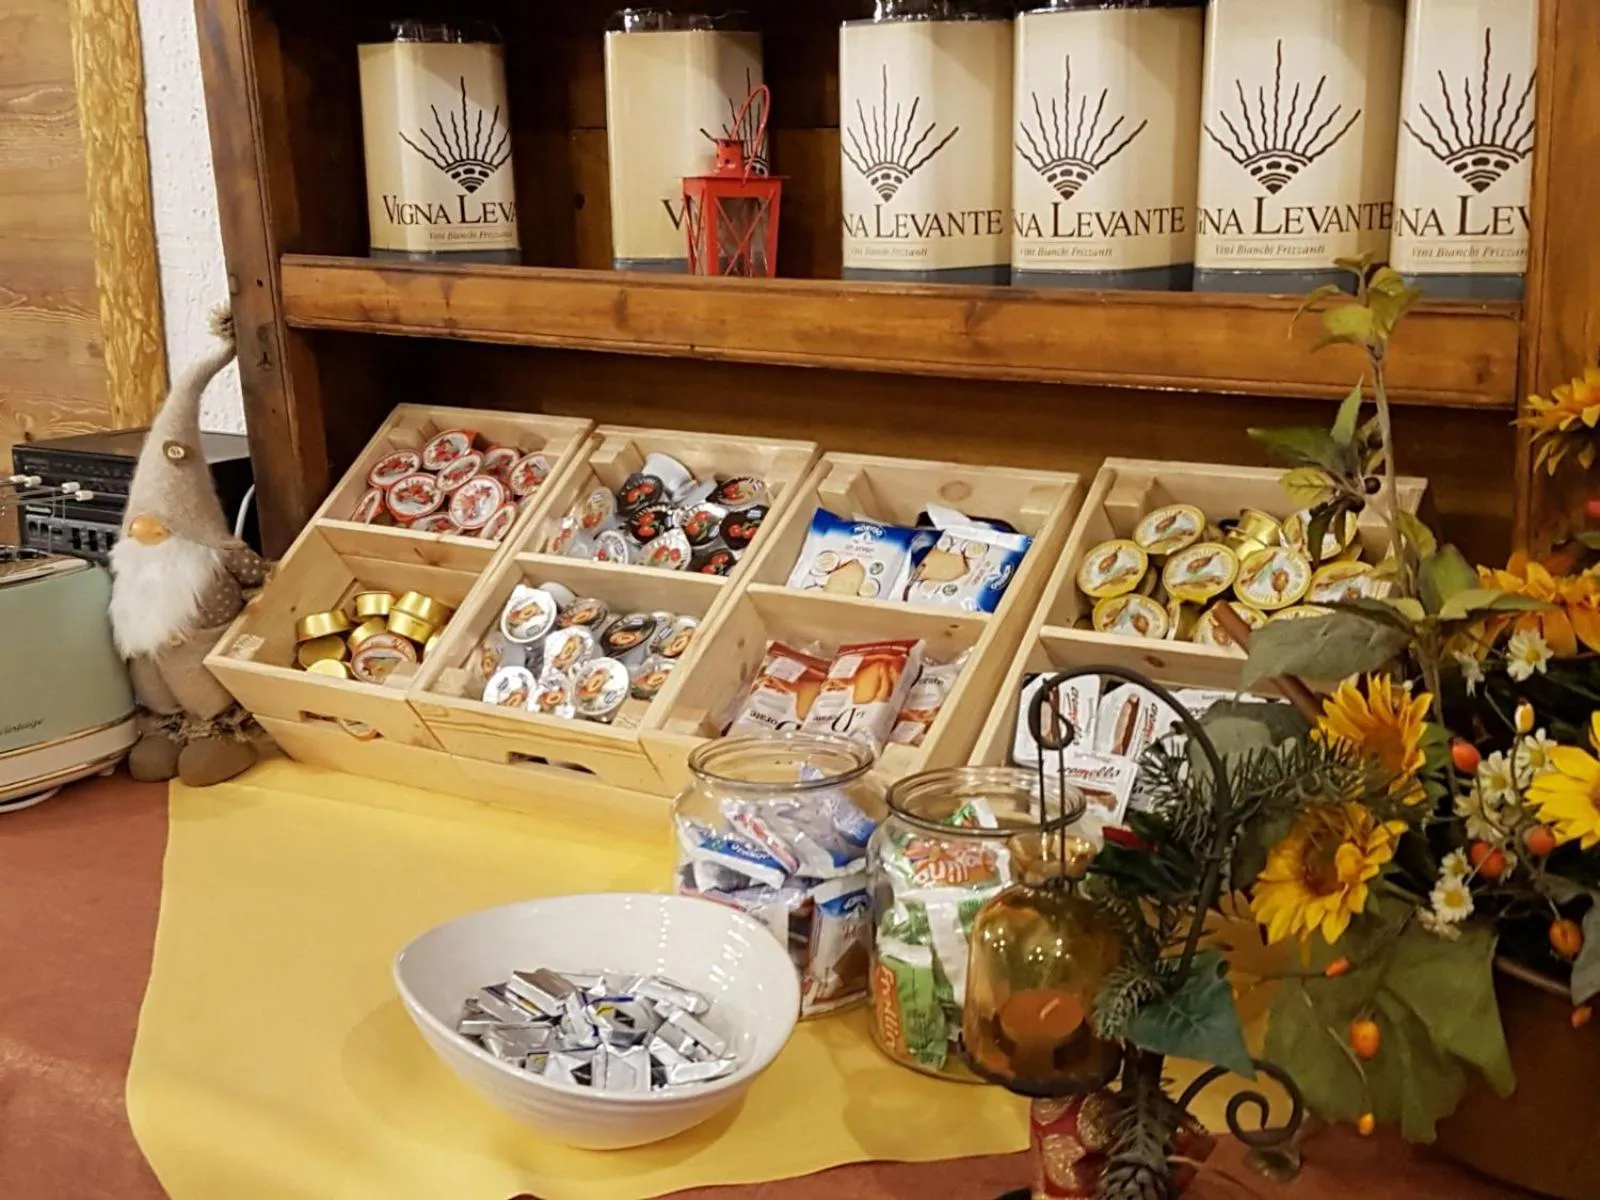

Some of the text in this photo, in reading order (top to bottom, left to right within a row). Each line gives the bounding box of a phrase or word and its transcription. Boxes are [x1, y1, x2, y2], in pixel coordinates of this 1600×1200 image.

[874, 203, 1003, 238] LEVANTE
[1051, 201, 1186, 238] LEVANTE
[1253, 196, 1393, 235] LEVANTE
[1394, 208, 1445, 237] NA
